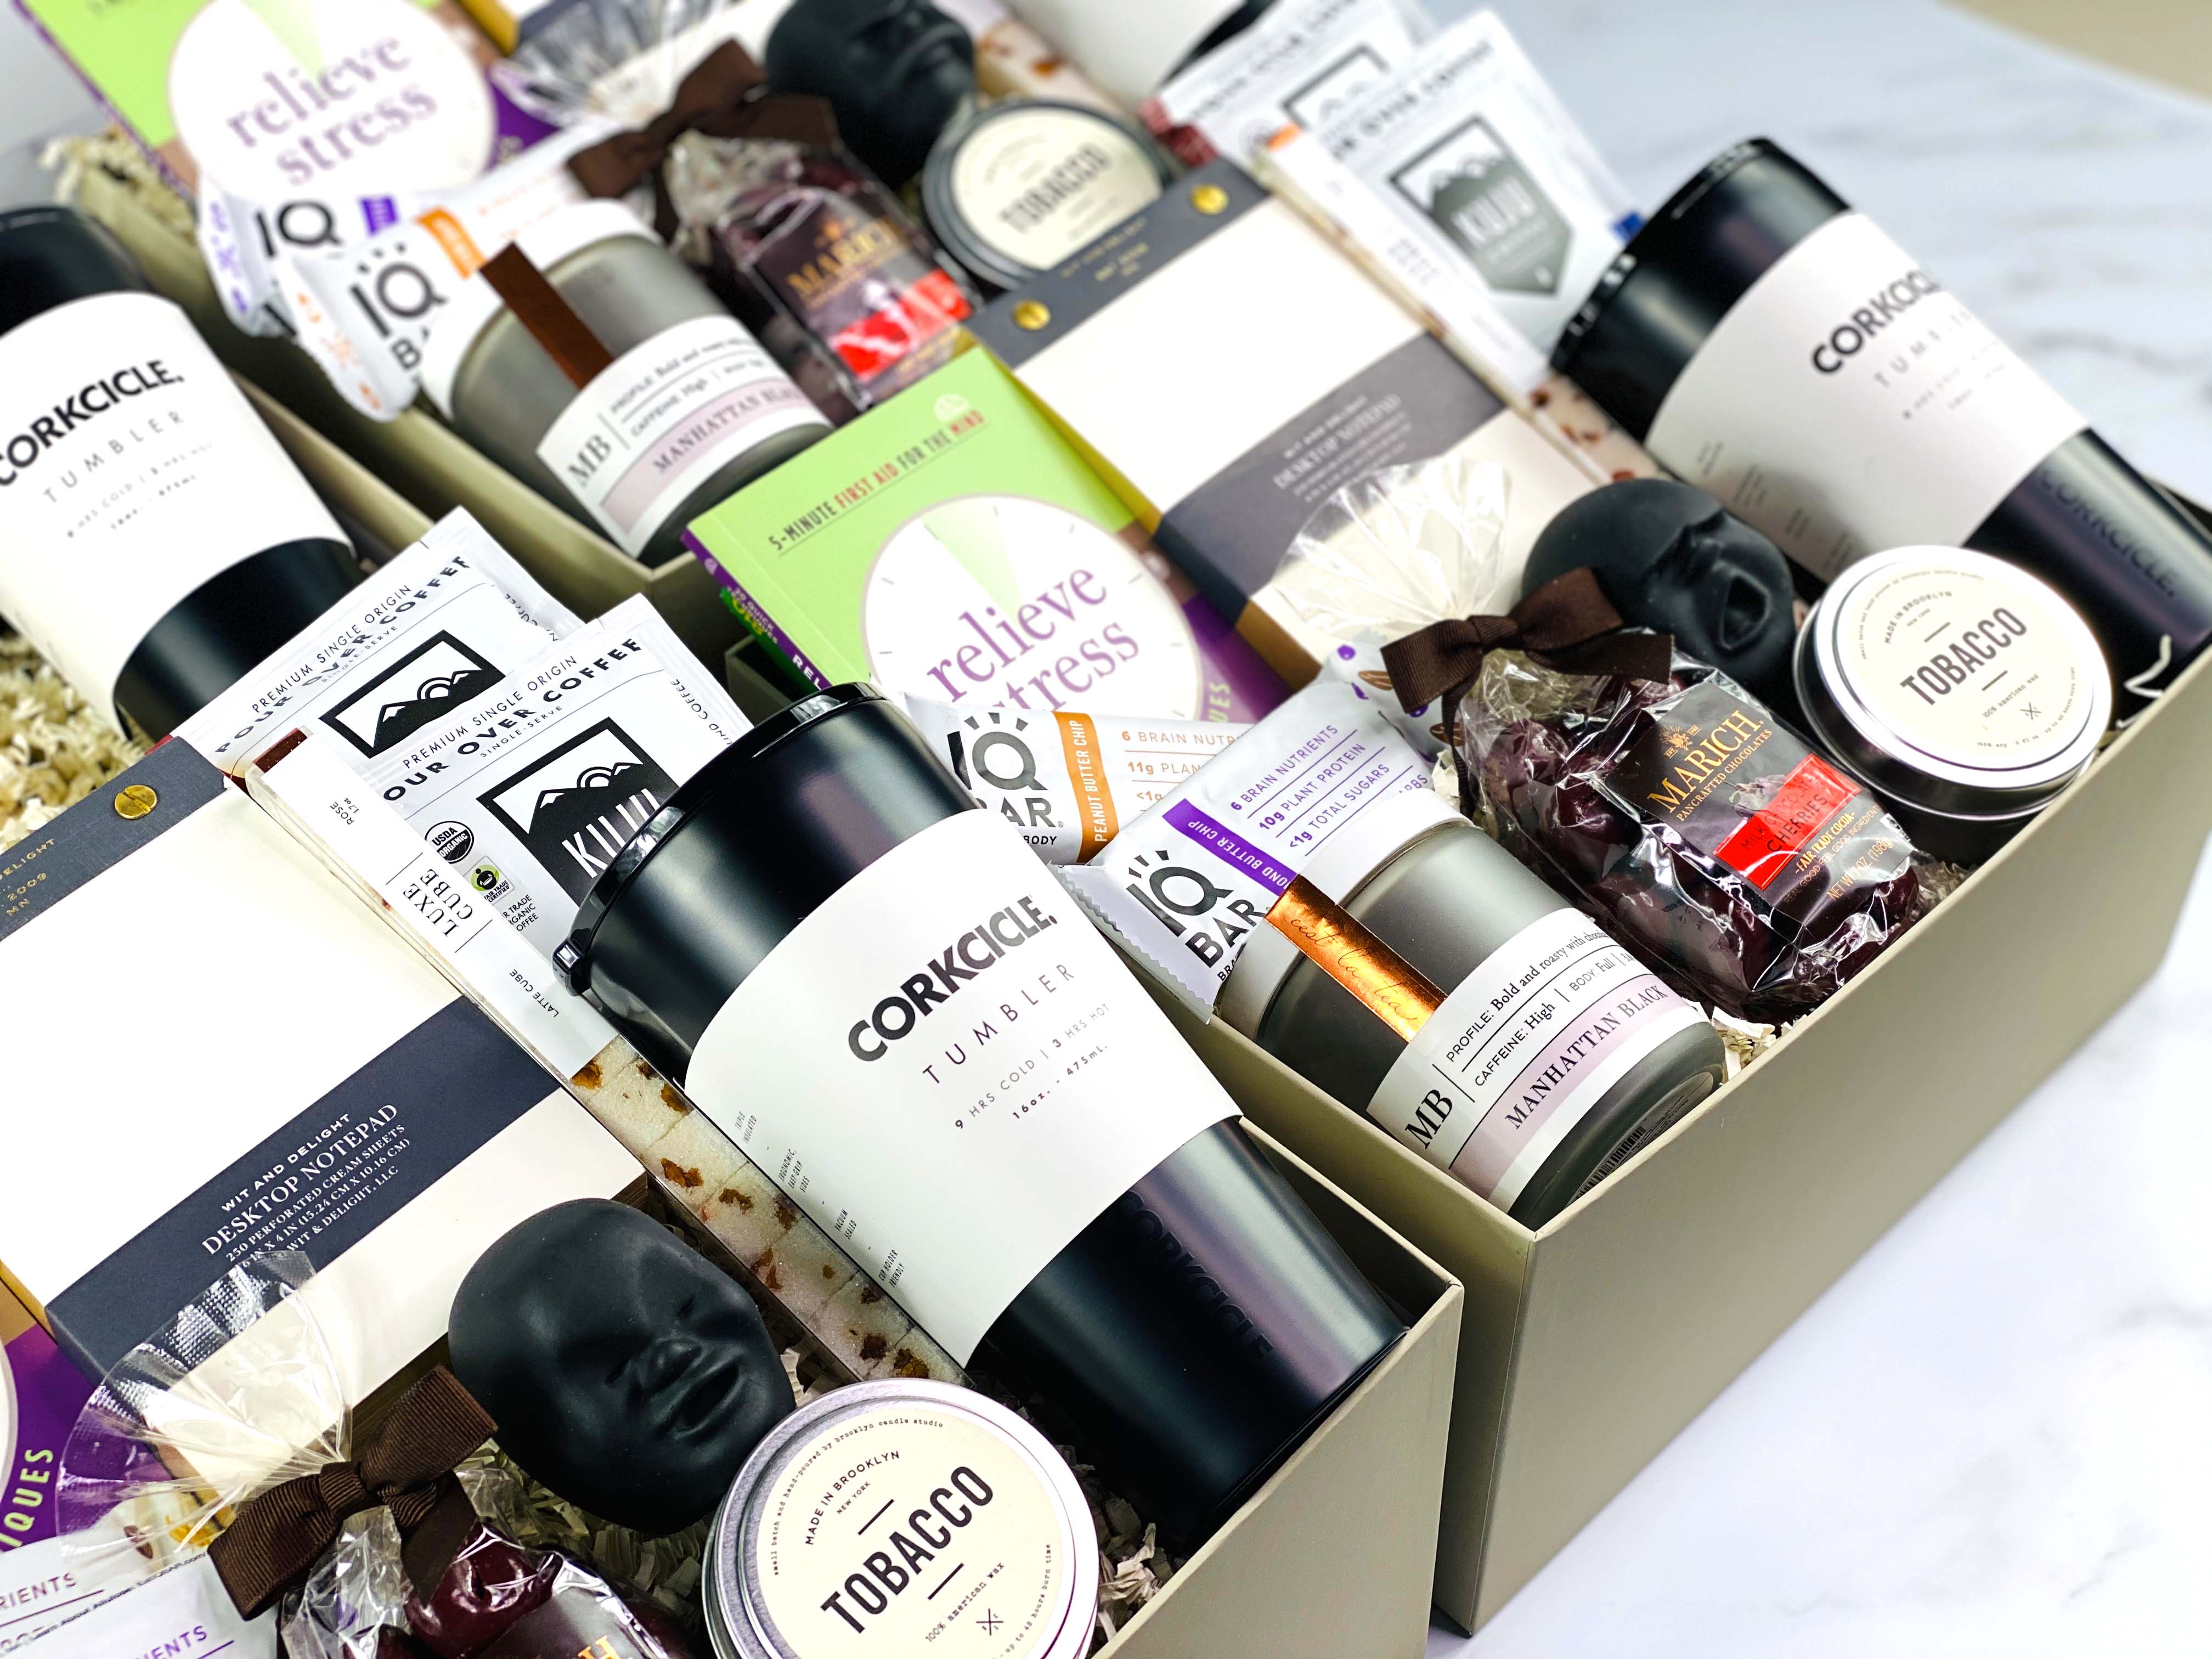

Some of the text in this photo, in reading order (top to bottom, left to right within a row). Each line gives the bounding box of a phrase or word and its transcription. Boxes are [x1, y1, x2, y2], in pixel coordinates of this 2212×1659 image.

[226, 36, 413, 148] relieve
[275, 83, 438, 187] stress
[256, 200, 343, 258] IQ
[351, 262, 447, 338] IQ
[42, 410, 184, 503] TUMBLER
[567, 433, 612, 488] MB
[653, 394, 760, 474] MANHATTAN
[769, 409, 985, 551] 5-MINUTE FIRST AID FOR THE MIND
[251, 584, 413, 713] PREMIUM SINGLE ORIGIN
[926, 569, 1108, 702] relieve
[1884, 590, 1953, 644] MADE IN BROOKLYN
[1899, 607, 2028, 706] TOBACCO
[215, 633, 373, 753] POUR OVER
[403, 654, 579, 770] PREMIUM SINGLE ORIGIN
[456, 637, 642, 756] OVER COFFEE
[670, 679, 708, 720] COFFEE
[1982, 706, 1997, 718] 100%
[480, 705, 563, 758] SINGLE-SERVE
[947, 731, 1048, 791] IQ
[1121, 731, 1187, 744] 6 BRAIN
[1647, 710, 1761, 813] MARICH
[1069, 720, 1108, 842] PEANUT BUTTER CHIP
[1127, 761, 1154, 775] 11g
[1231, 724, 1339, 811] 6 BRAIN NUTRIENTS
[1259, 743, 1366, 831] 10g PLANT PROTEIN
[1676, 729, 1773, 822] PANCRAFTED CHOCOLATES
[330, 802, 354, 825] ROSE
[432, 826, 458, 847] USDA
[1290, 763, 1390, 850] <1g TOTAL SUGARS
[1741, 825, 1765, 850] MILK
[1767, 794, 1828, 851] CHERRIES
[439, 832, 468, 858] ORGANIC
[1188, 819, 1263, 870] BUTTER CHIP
[1800, 834, 1852, 887] GOOD GOOD
[1811, 830, 1836, 854] TRADE
[5, 898, 30, 917] MN
[7, 872, 47, 902] 2009
[402, 882, 459, 936] LUXE
[419, 868, 473, 920] CUBE
[488, 884, 510, 902] CERTIFIED
[494, 879, 509, 892] TRADE
[508, 894, 532, 913] TRADE
[1126, 866, 1234, 938] IQ
[1827, 882, 1845, 900] NET
[1185, 899, 1267, 969] BAR
[508, 968, 560, 1018] LATTE CUBE
[848, 895, 1058, 1062] CORKCICLE.
[1446, 931, 1586, 1063] PROFILE: Bold and roasty with
[923, 964, 1074, 1084] TUMBLER
[1475, 957, 1616, 1087] CAFFEINE: High BODY: Full
[1505, 985, 1668, 1129] MANHATTAN BLACK
[955, 1003, 1111, 1130] 9 HRS COLD 3 HRS HOT
[743, 1115, 757, 1144] INSULATED
[1012, 1090, 1051, 1119] 16oz.
[1404, 1088, 1453, 1149] MB
[202, 1104, 398, 1256] DESKTOP NOTEPAD
[222, 1113, 350, 1212] WIT AND DELIGHT
[225, 1124, 405, 1262] 250 PERFORATED CREAM SHEETS
[264, 1138, 411, 1251] X 4 IN (15.24 CM X 10.16 CM)
[799, 1176, 810, 1193] SIDES
[286, 1166, 399, 1251] WIT & DELIGHT, LLC
[834, 1209, 848, 1232] VACUUM
[844, 1219, 857, 1240] SEALED
[878, 1249, 899, 1282] CUP HOLDER
[889, 1262, 905, 1288] FRIENDLY
[771, 1521, 780, 1546] batch
[777, 1501, 786, 1516] and
[822, 1442, 832, 1451] by
[834, 1423, 874, 1443] brooklyn
[879, 1418, 909, 1426] candle
[913, 1418, 944, 1428] studio
[805, 1451, 900, 1545] MADE IN BROOKLYN
[837, 1481, 871, 1515] NEW YORK
[821, 1466, 994, 1634] TOBACCO
[926, 1562, 1005, 1642] 100% american wax
[1005, 1644, 1014, 1653] up
[1031, 1594, 1045, 1618] hours
[1041, 1569, 1051, 1590] burn
